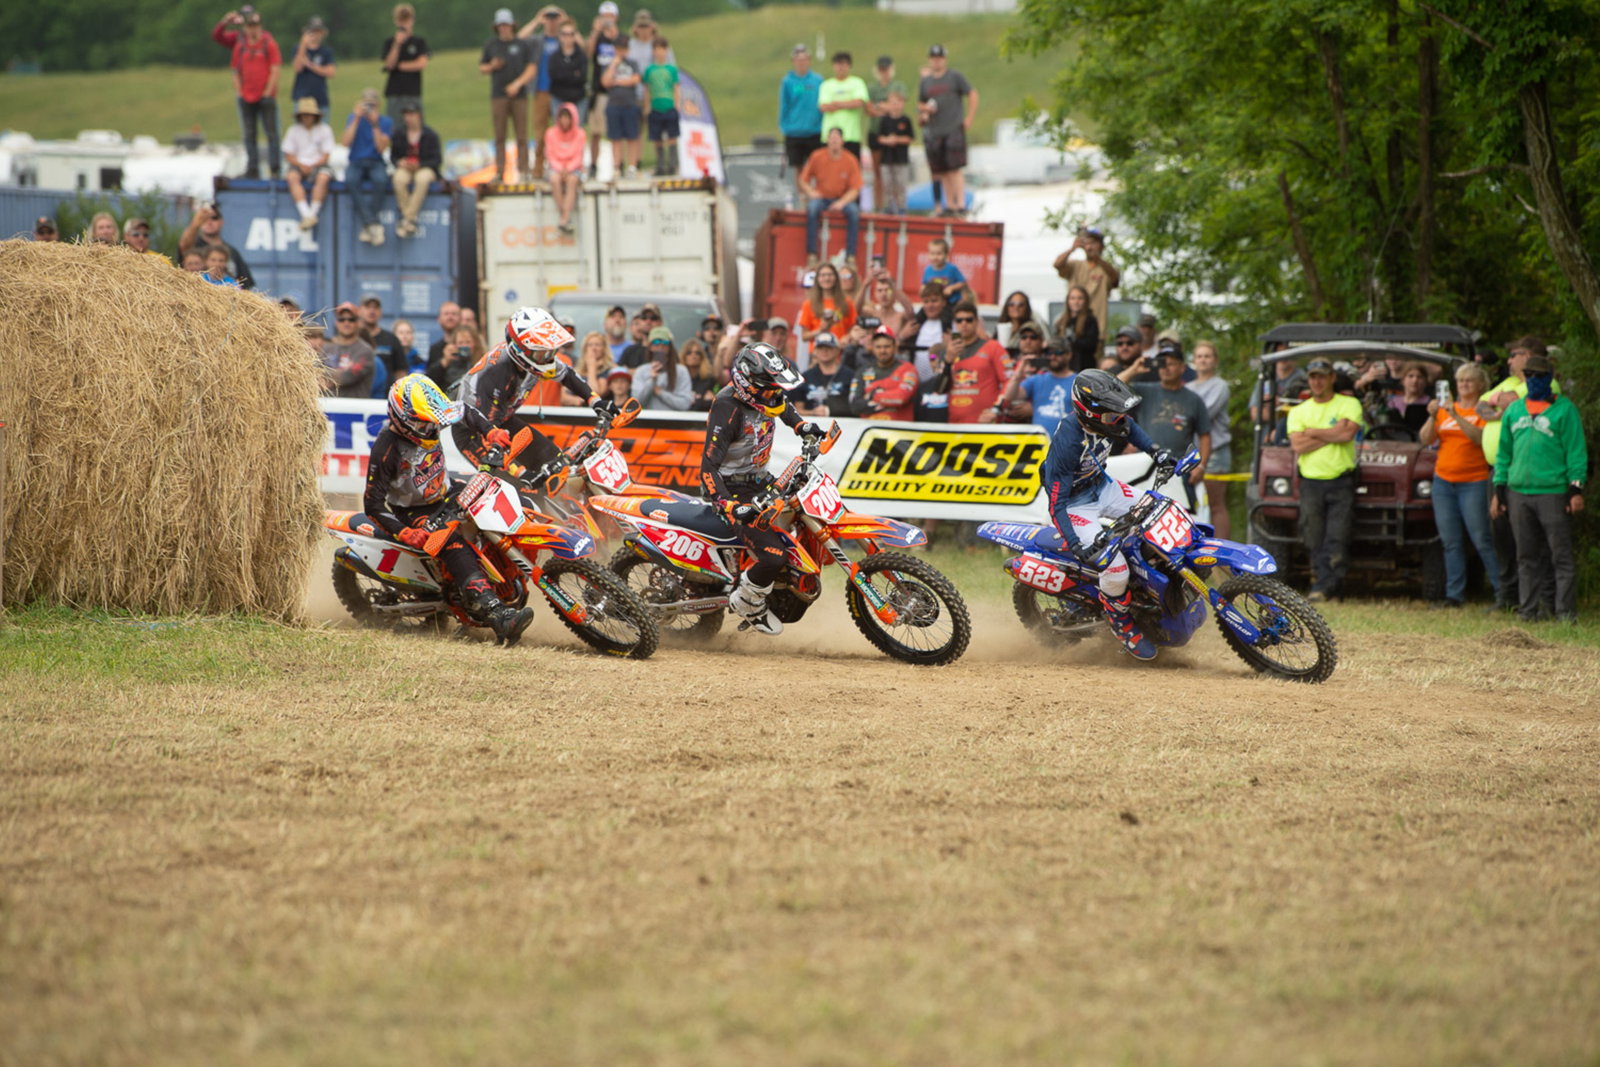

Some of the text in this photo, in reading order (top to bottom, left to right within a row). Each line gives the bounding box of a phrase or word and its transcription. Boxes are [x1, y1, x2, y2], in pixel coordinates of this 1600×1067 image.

[245, 217, 319, 251] APL
[595, 449, 628, 487] 530
[857, 438, 1044, 480] MOOSE
[811, 477, 841, 520] 206
[847, 479, 1029, 497] UTILITY DIVISION
[492, 489, 518, 528] 1
[995, 537, 1025, 551] DUNLOP
[1150, 503, 1192, 552] 523
[376, 548, 401, 574] 1
[658, 530, 705, 561] 206
[1018, 560, 1066, 592] 523
[1225, 617, 1252, 636] DUNLOP
